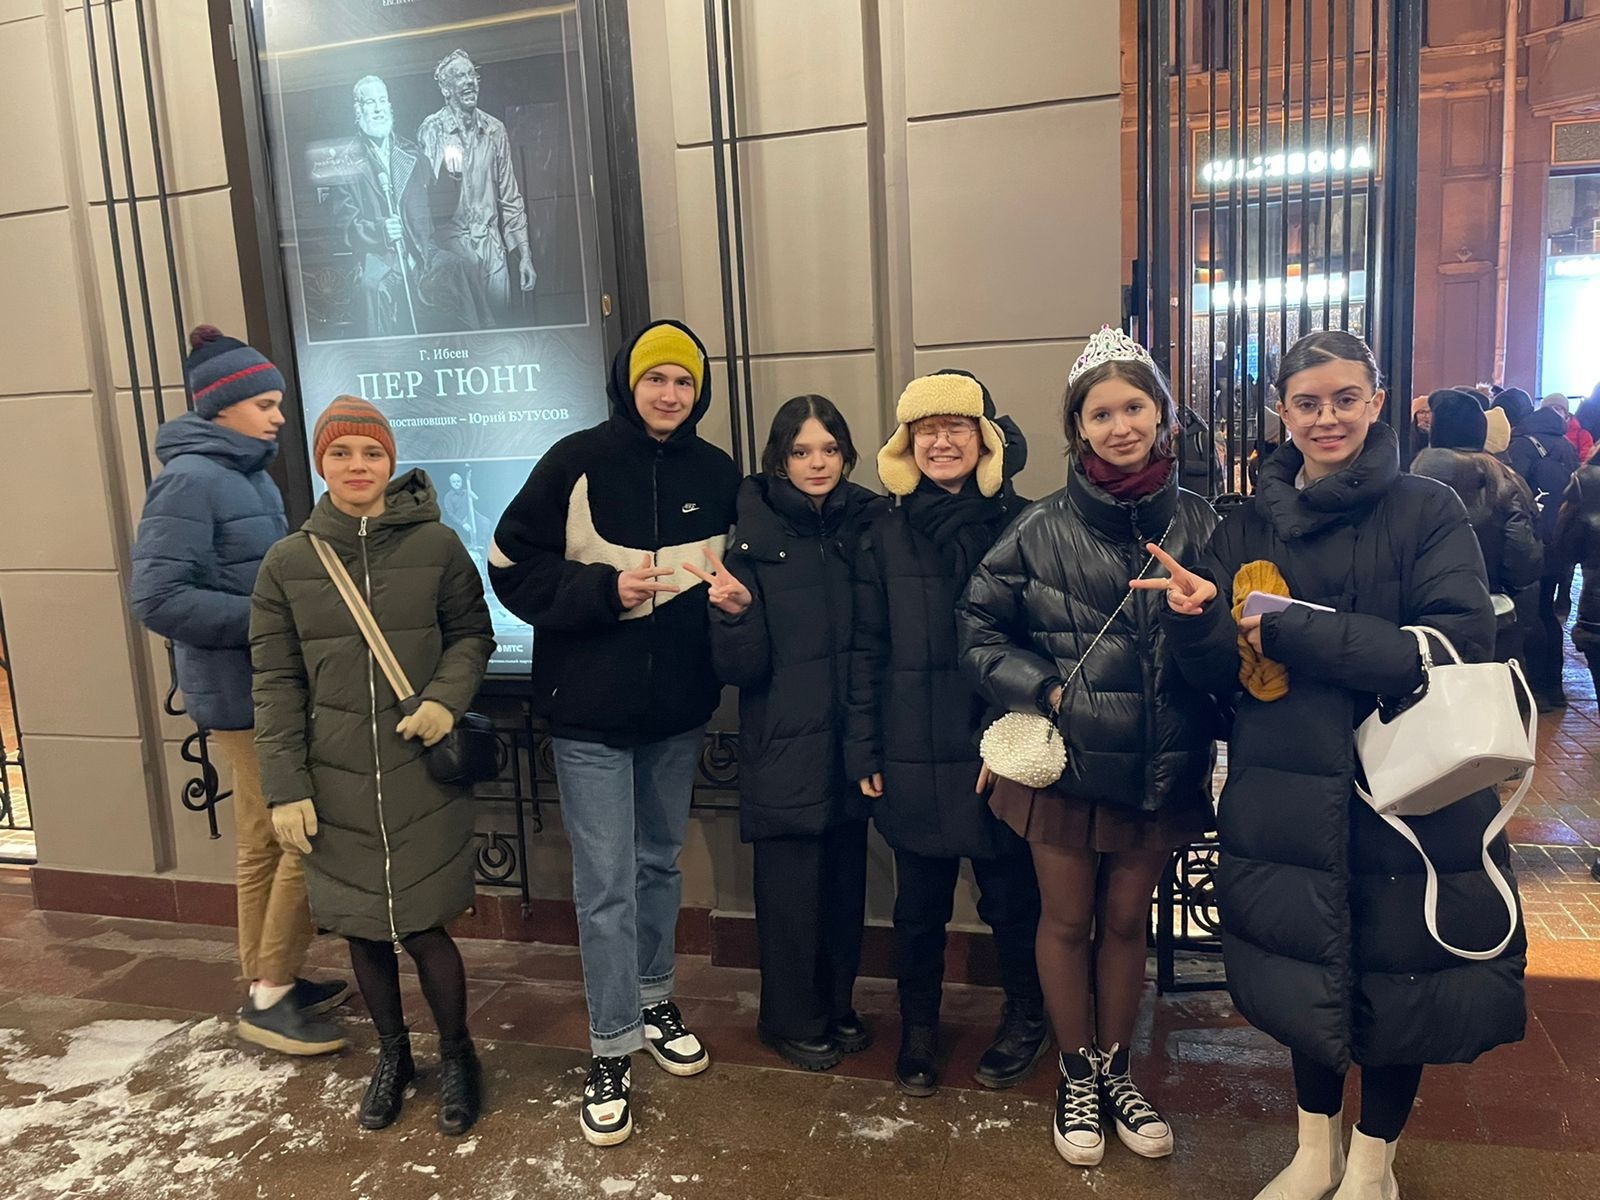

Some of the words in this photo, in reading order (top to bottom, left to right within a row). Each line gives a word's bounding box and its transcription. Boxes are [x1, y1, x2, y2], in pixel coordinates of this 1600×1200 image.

[419, 349, 430, 361] Г.
[433, 348, 469, 360] Ибсен
[357, 370, 424, 401] ПЕР
[434, 363, 541, 397] ГЮНТ
[469, 412, 506, 426] Юрий
[509, 408, 569, 423] БУТУСОВ
[503, 644, 523, 653] МТС
